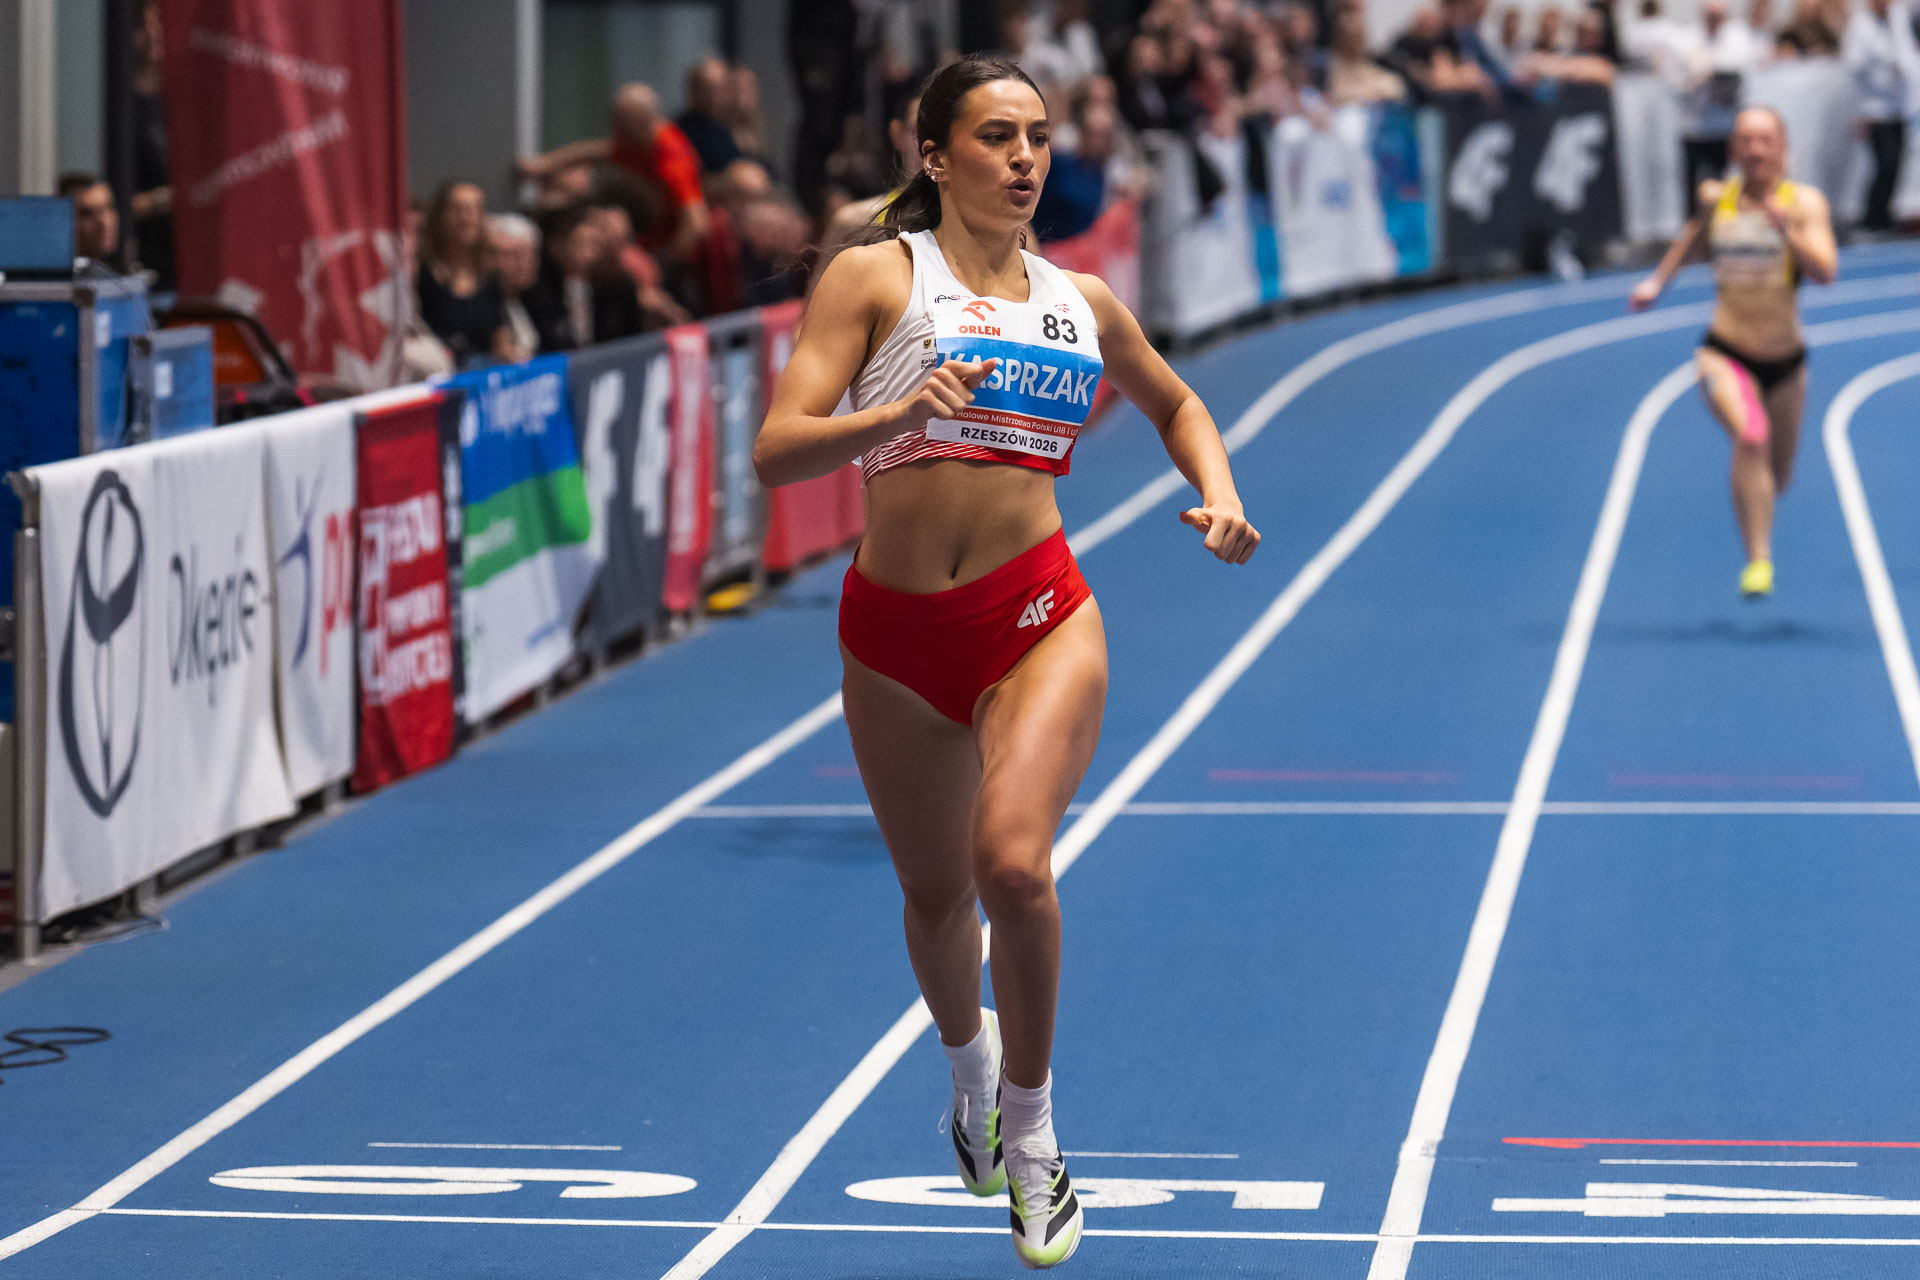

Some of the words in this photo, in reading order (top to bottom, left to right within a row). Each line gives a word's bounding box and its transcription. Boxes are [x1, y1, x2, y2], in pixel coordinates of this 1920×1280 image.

[958, 325, 1001, 337] ORLEN
[1042, 313, 1078, 344] 83
[991, 414, 1031, 428] Mistrzostwa
[1031, 421, 1053, 432] Polski
[1053, 425, 1066, 435] U18
[960, 426, 1028, 447] RZESZÓW
[1029, 437, 1058, 453] 2026
[1016, 588, 1055, 629] 4F
[209, 1165, 698, 1198] 6
